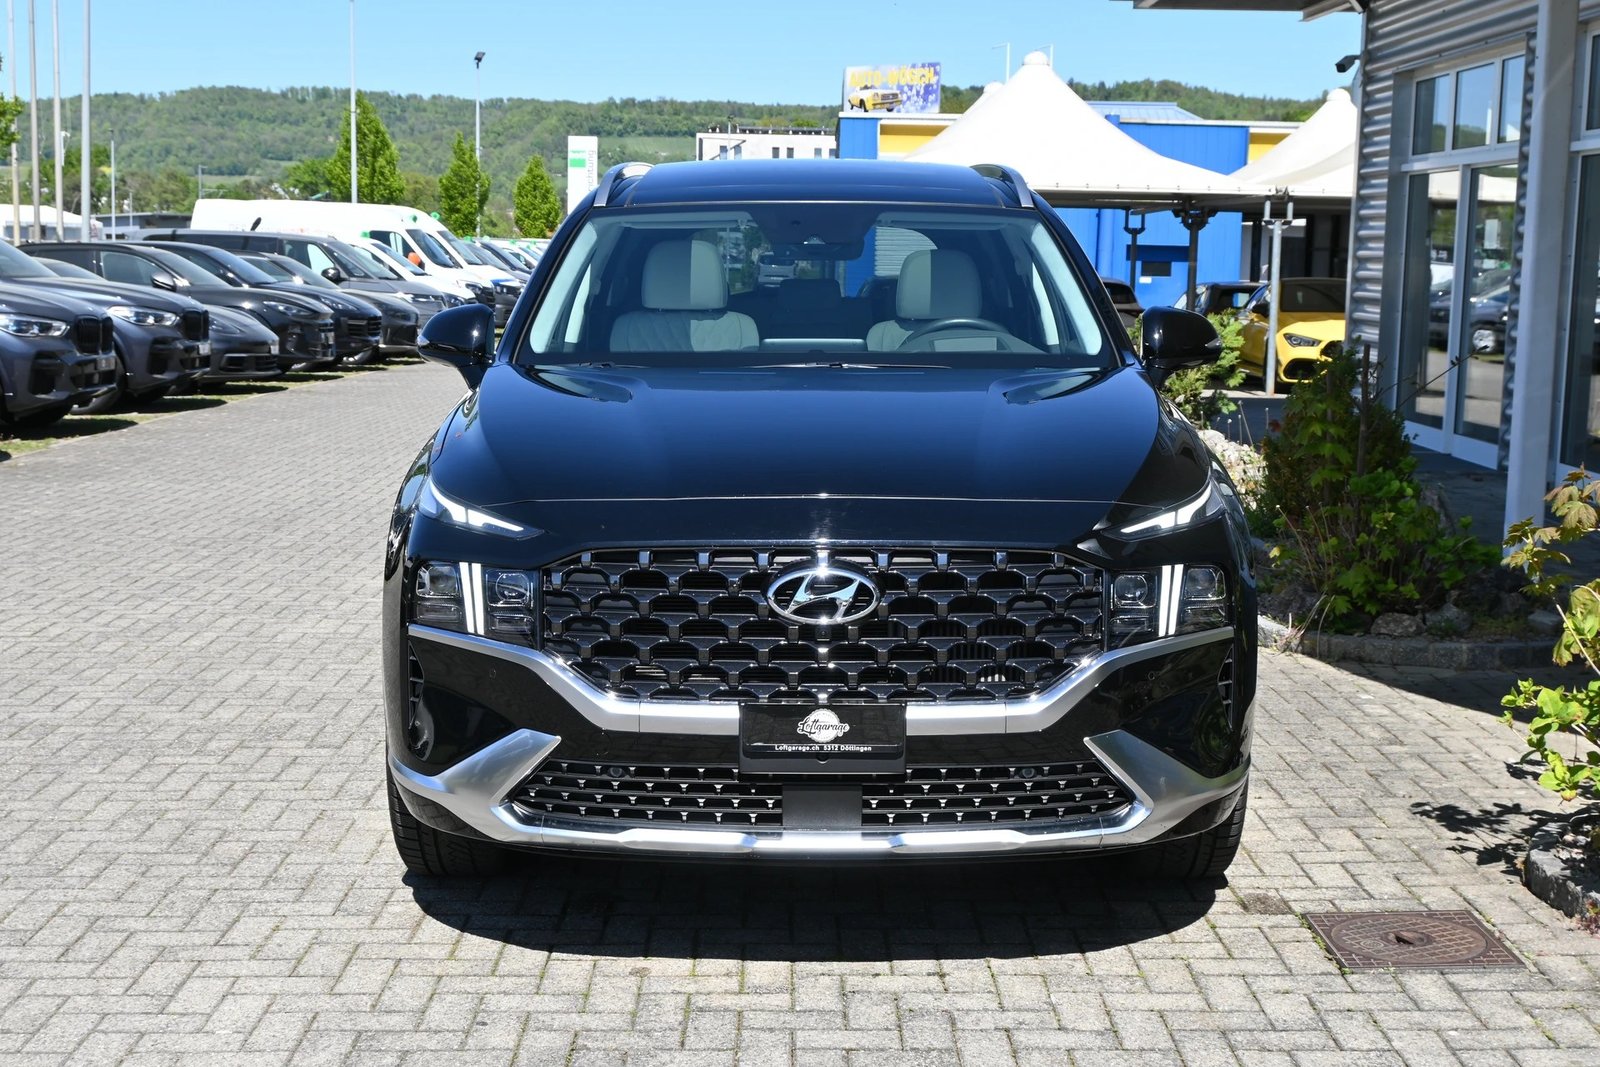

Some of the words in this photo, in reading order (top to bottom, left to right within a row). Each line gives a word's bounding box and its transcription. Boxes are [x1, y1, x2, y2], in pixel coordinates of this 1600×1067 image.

[797, 716, 849, 736] Loftgarage
[774, 744, 820, 752] Loftgarage.ch
[840, 744, 872, 752] Döttingen
